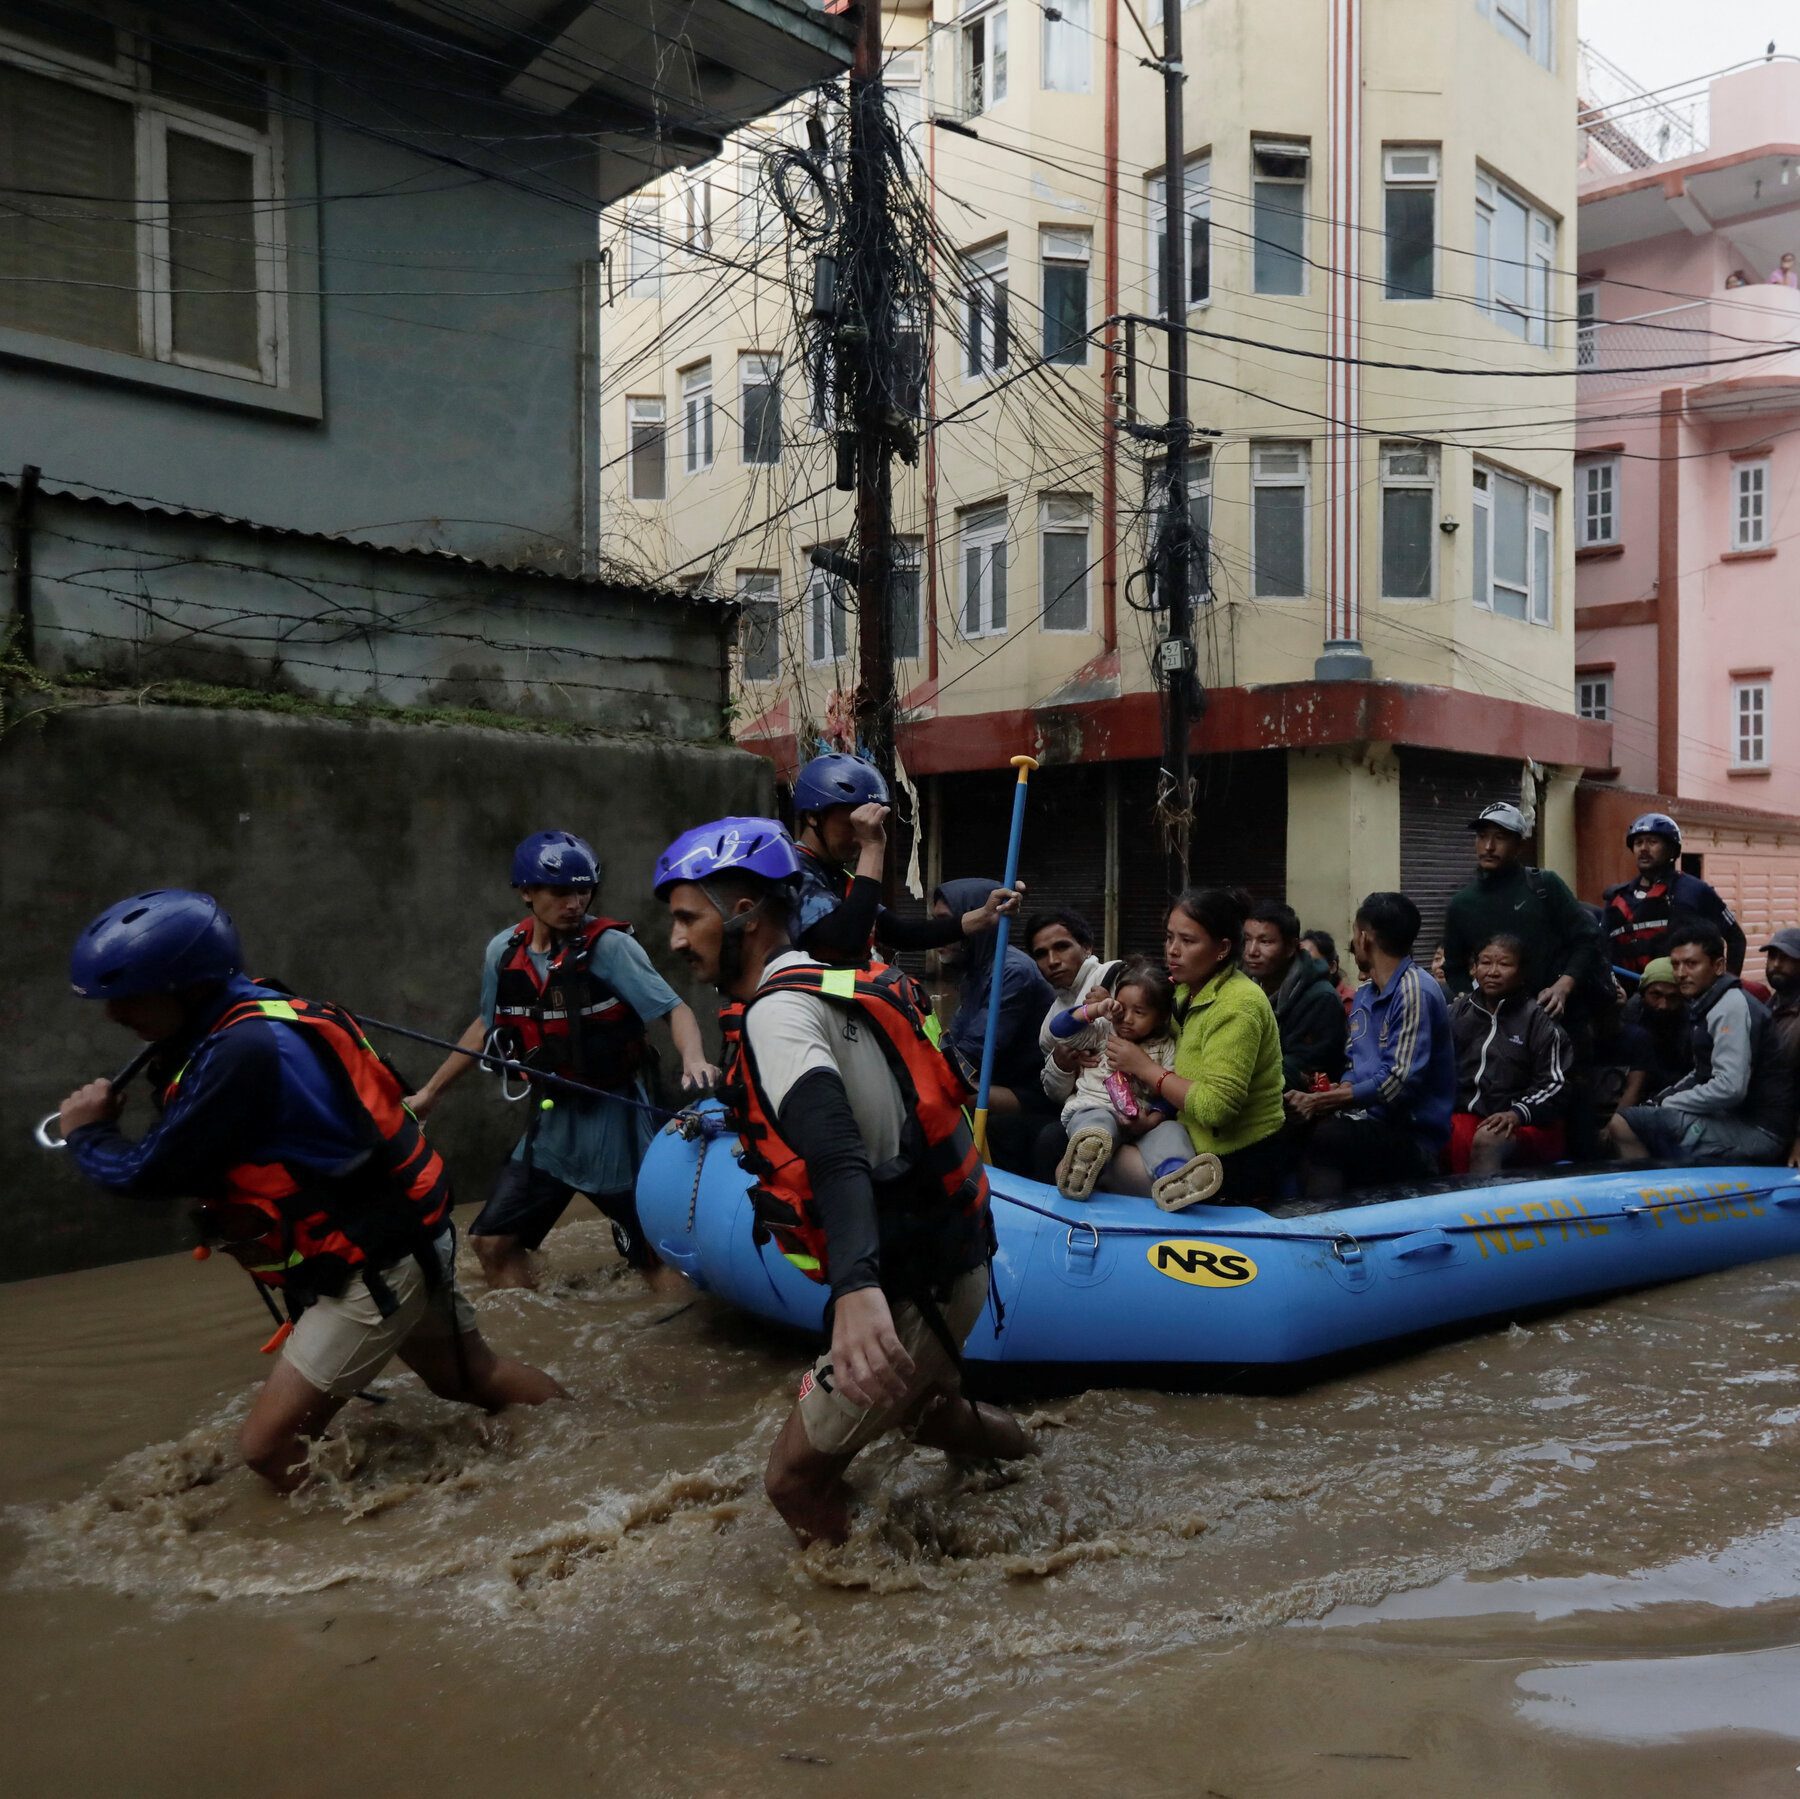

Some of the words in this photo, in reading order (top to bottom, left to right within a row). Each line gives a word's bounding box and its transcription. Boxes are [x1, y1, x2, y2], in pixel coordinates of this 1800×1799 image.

[1461, 1195, 1609, 1259] NEPAL
[1639, 1182, 1766, 1229] POLICE
[1158, 1245, 1250, 1280] NRS
